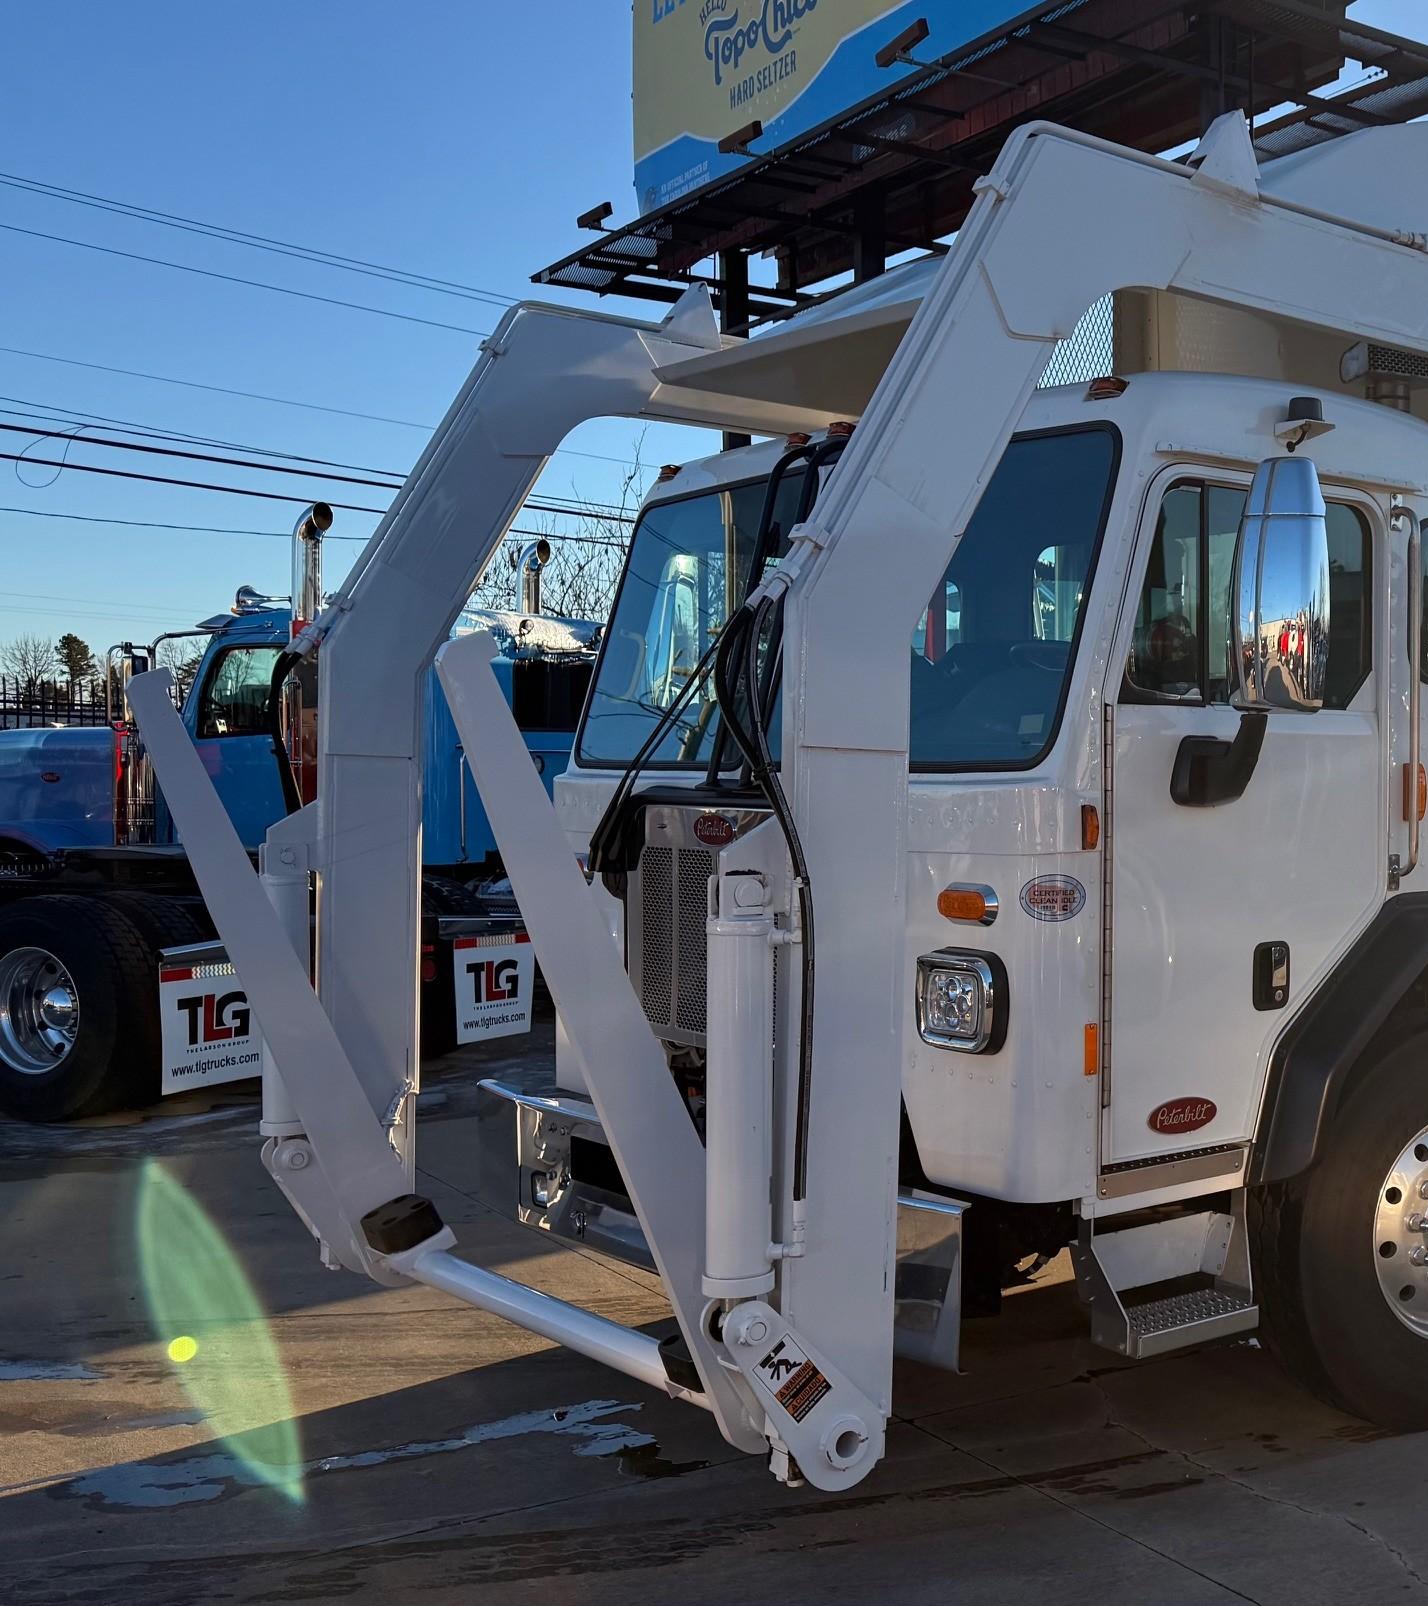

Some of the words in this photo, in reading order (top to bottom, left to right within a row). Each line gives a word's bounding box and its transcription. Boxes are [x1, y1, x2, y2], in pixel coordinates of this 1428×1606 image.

[704, 8, 759, 86] Topo
[729, 75, 755, 110] HARD
[756, 49, 797, 93] SELTZER
[1029, 897, 1058, 905] CLEAN
[1061, 896, 1078, 904] IDLE
[1033, 889, 1075, 897] CERTIFIED
[466, 958, 519, 1004] TLG
[177, 990, 251, 1046] TLG
[462, 1012, 526, 1030] www.tlgtrucks.com
[171, 1052, 260, 1078] www.tlgtrucks.com
[1156, 1103, 1212, 1129] Peterbilt
